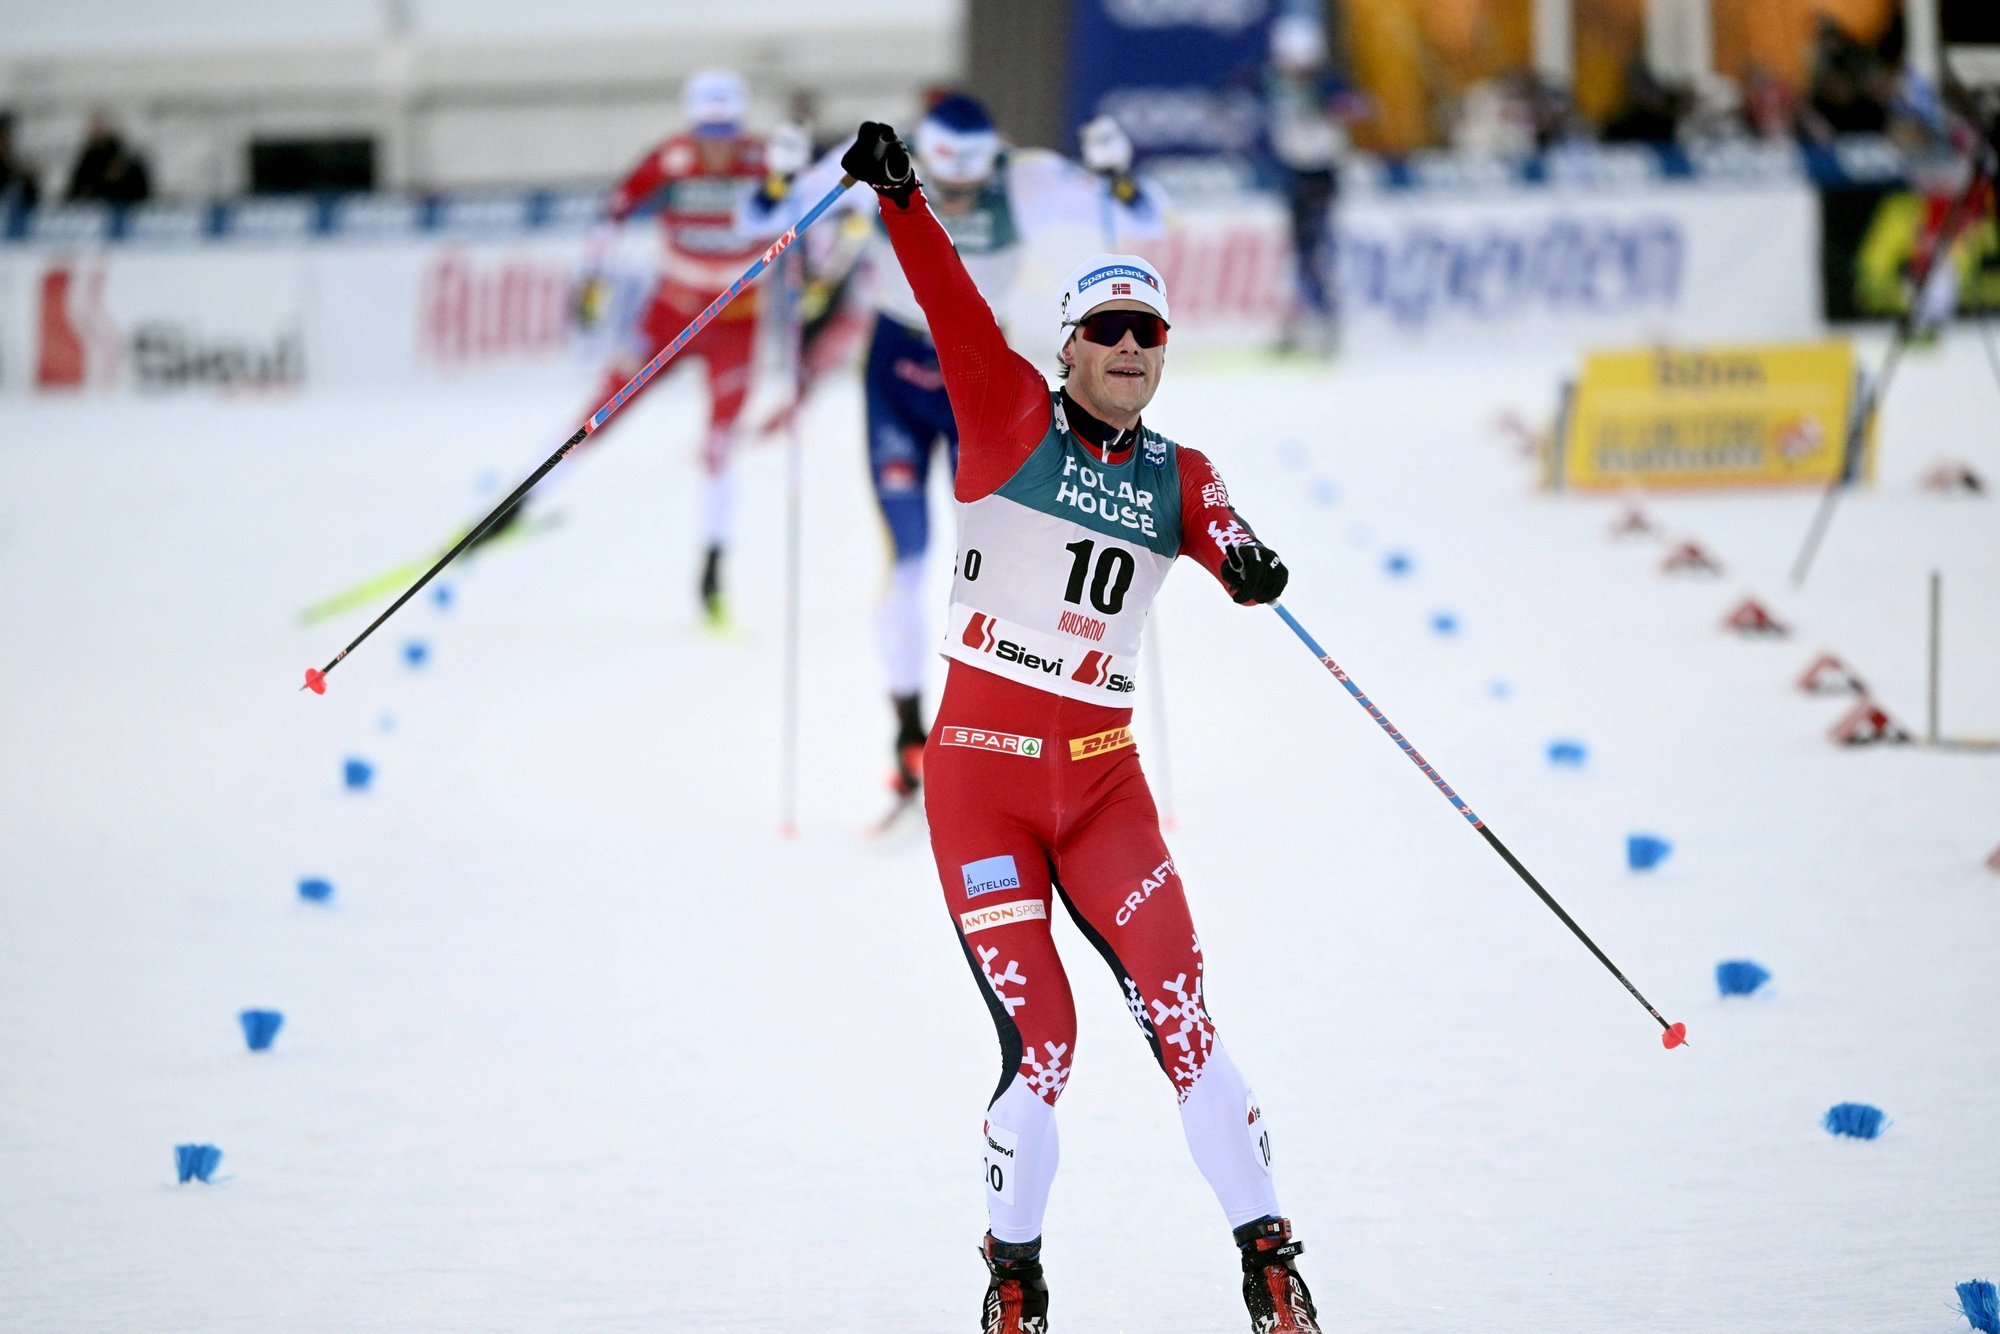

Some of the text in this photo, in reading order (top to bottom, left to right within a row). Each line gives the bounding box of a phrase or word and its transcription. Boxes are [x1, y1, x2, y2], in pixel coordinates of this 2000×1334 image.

[1080, 268, 1147, 288] SpareBank
[1063, 455, 1153, 511] POLAR
[1201, 482, 1220, 509] ADE
[1056, 481, 1157, 538] HOUSE
[954, 549, 982, 582] 0
[1064, 538, 1136, 615] 10
[1058, 611, 1106, 642] KUUSAMO
[996, 640, 1063, 677] Sievi
[1106, 674, 1136, 693] Sie
[955, 730, 1018, 750] SPAR
[1082, 729, 1130, 755] DHL
[968, 877, 1018, 896] ENTELIOS
[1115, 860, 1175, 926] CRAFT
[964, 904, 1044, 928] ANTON SPORT
[988, 1136, 1014, 1158] Sievi
[1259, 1130, 1271, 1167] 10
